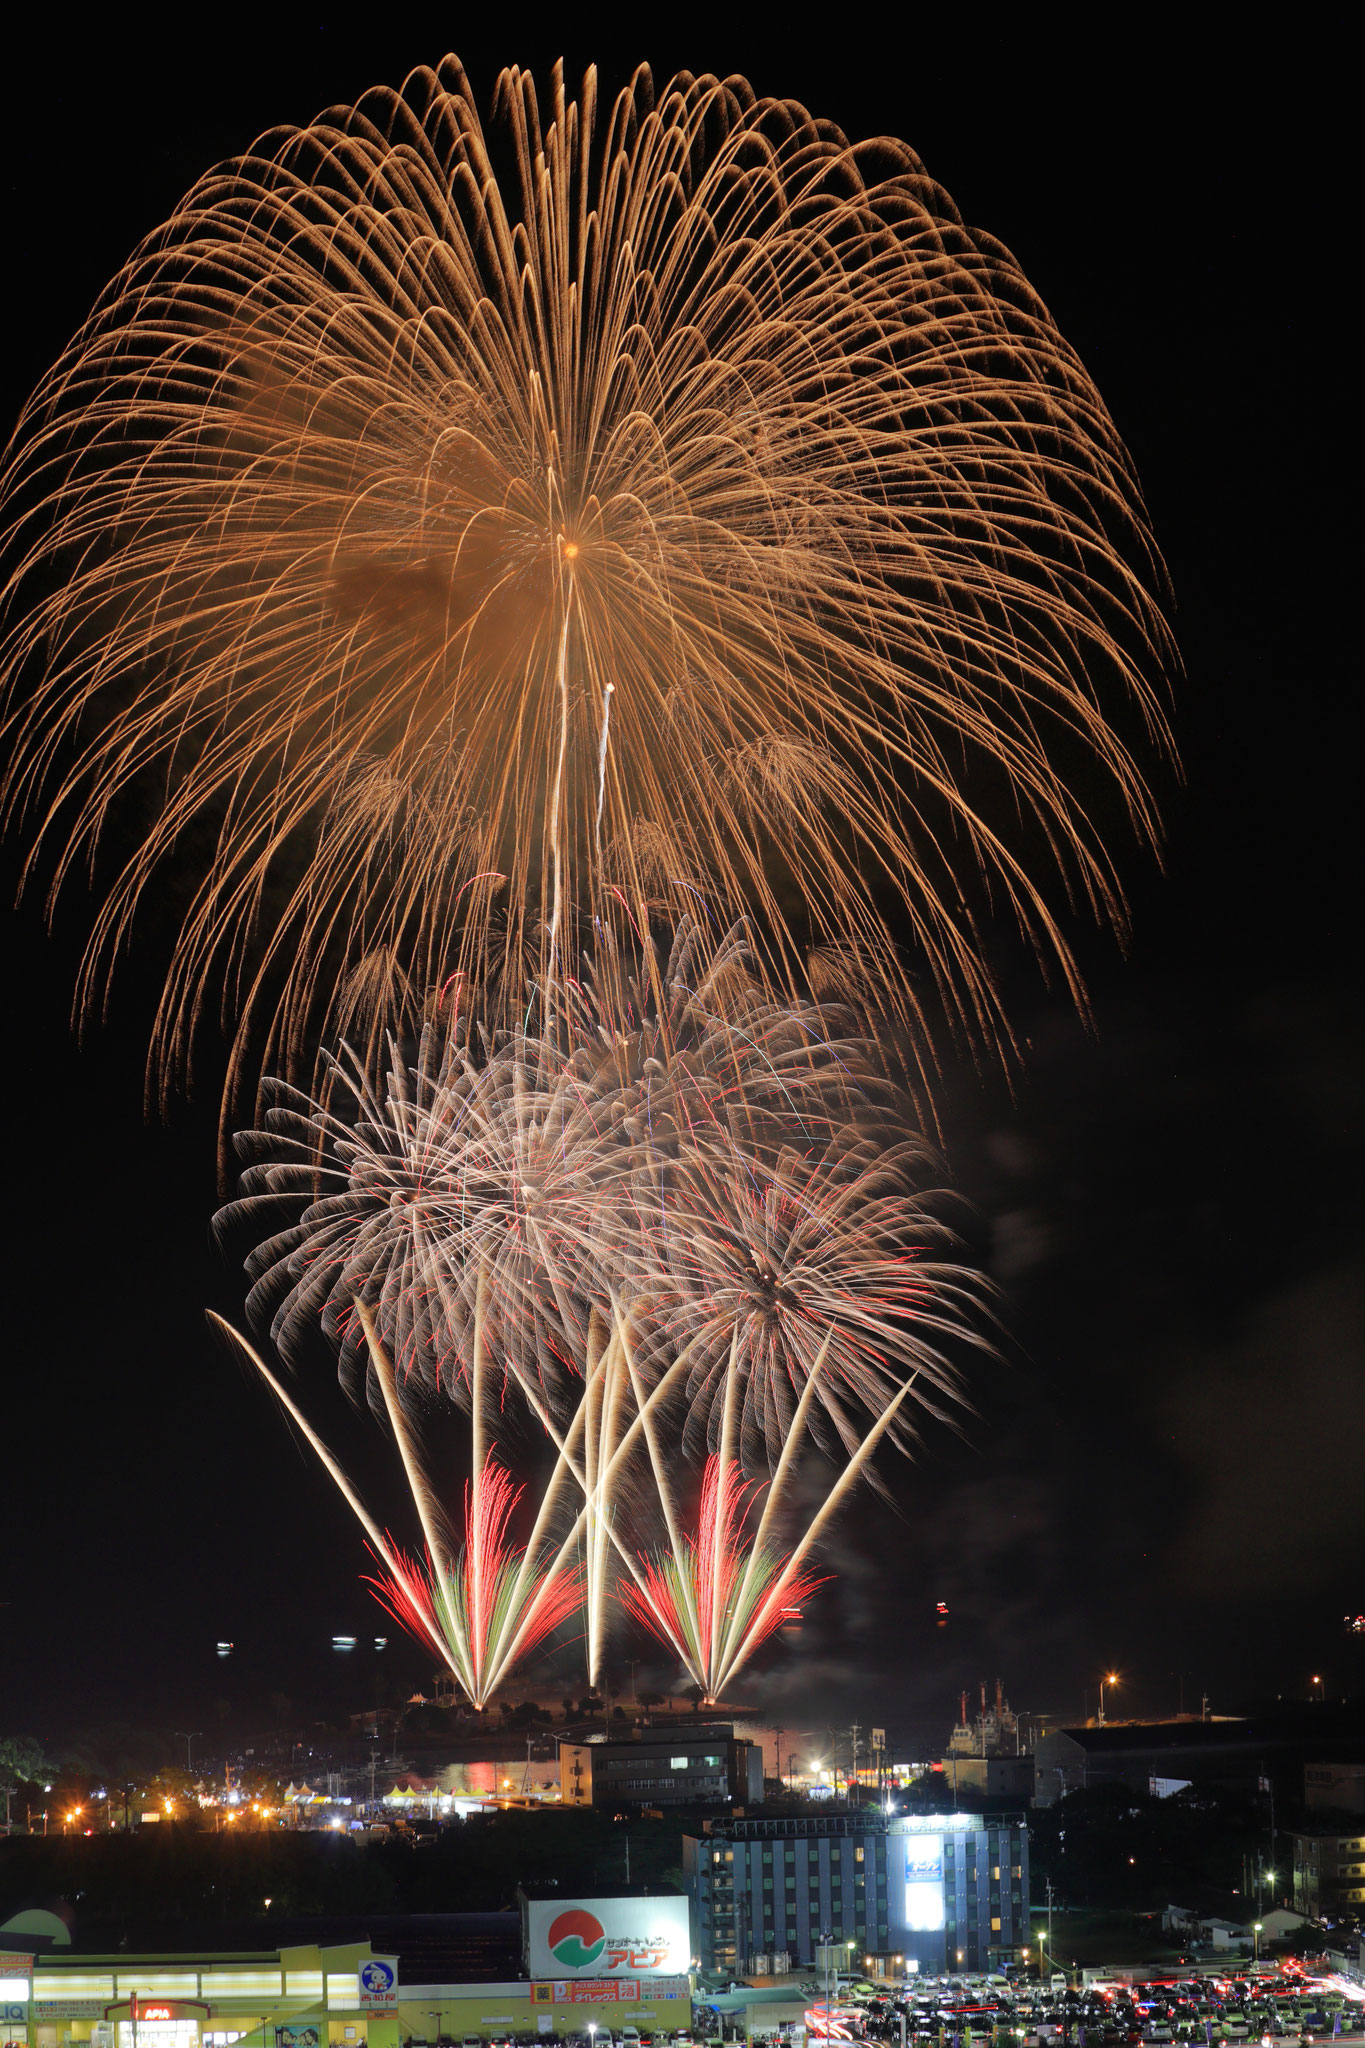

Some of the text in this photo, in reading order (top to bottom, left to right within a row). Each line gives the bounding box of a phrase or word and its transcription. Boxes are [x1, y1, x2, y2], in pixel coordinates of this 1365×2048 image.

[361, 1993, 396, 2001] 西松屋
[536, 1987, 550, 2000] 薬
[575, 1992, 616, 2002] ダイレックス
[621, 1984, 635, 1998] 酒
[145, 2008, 170, 2020] APIA
